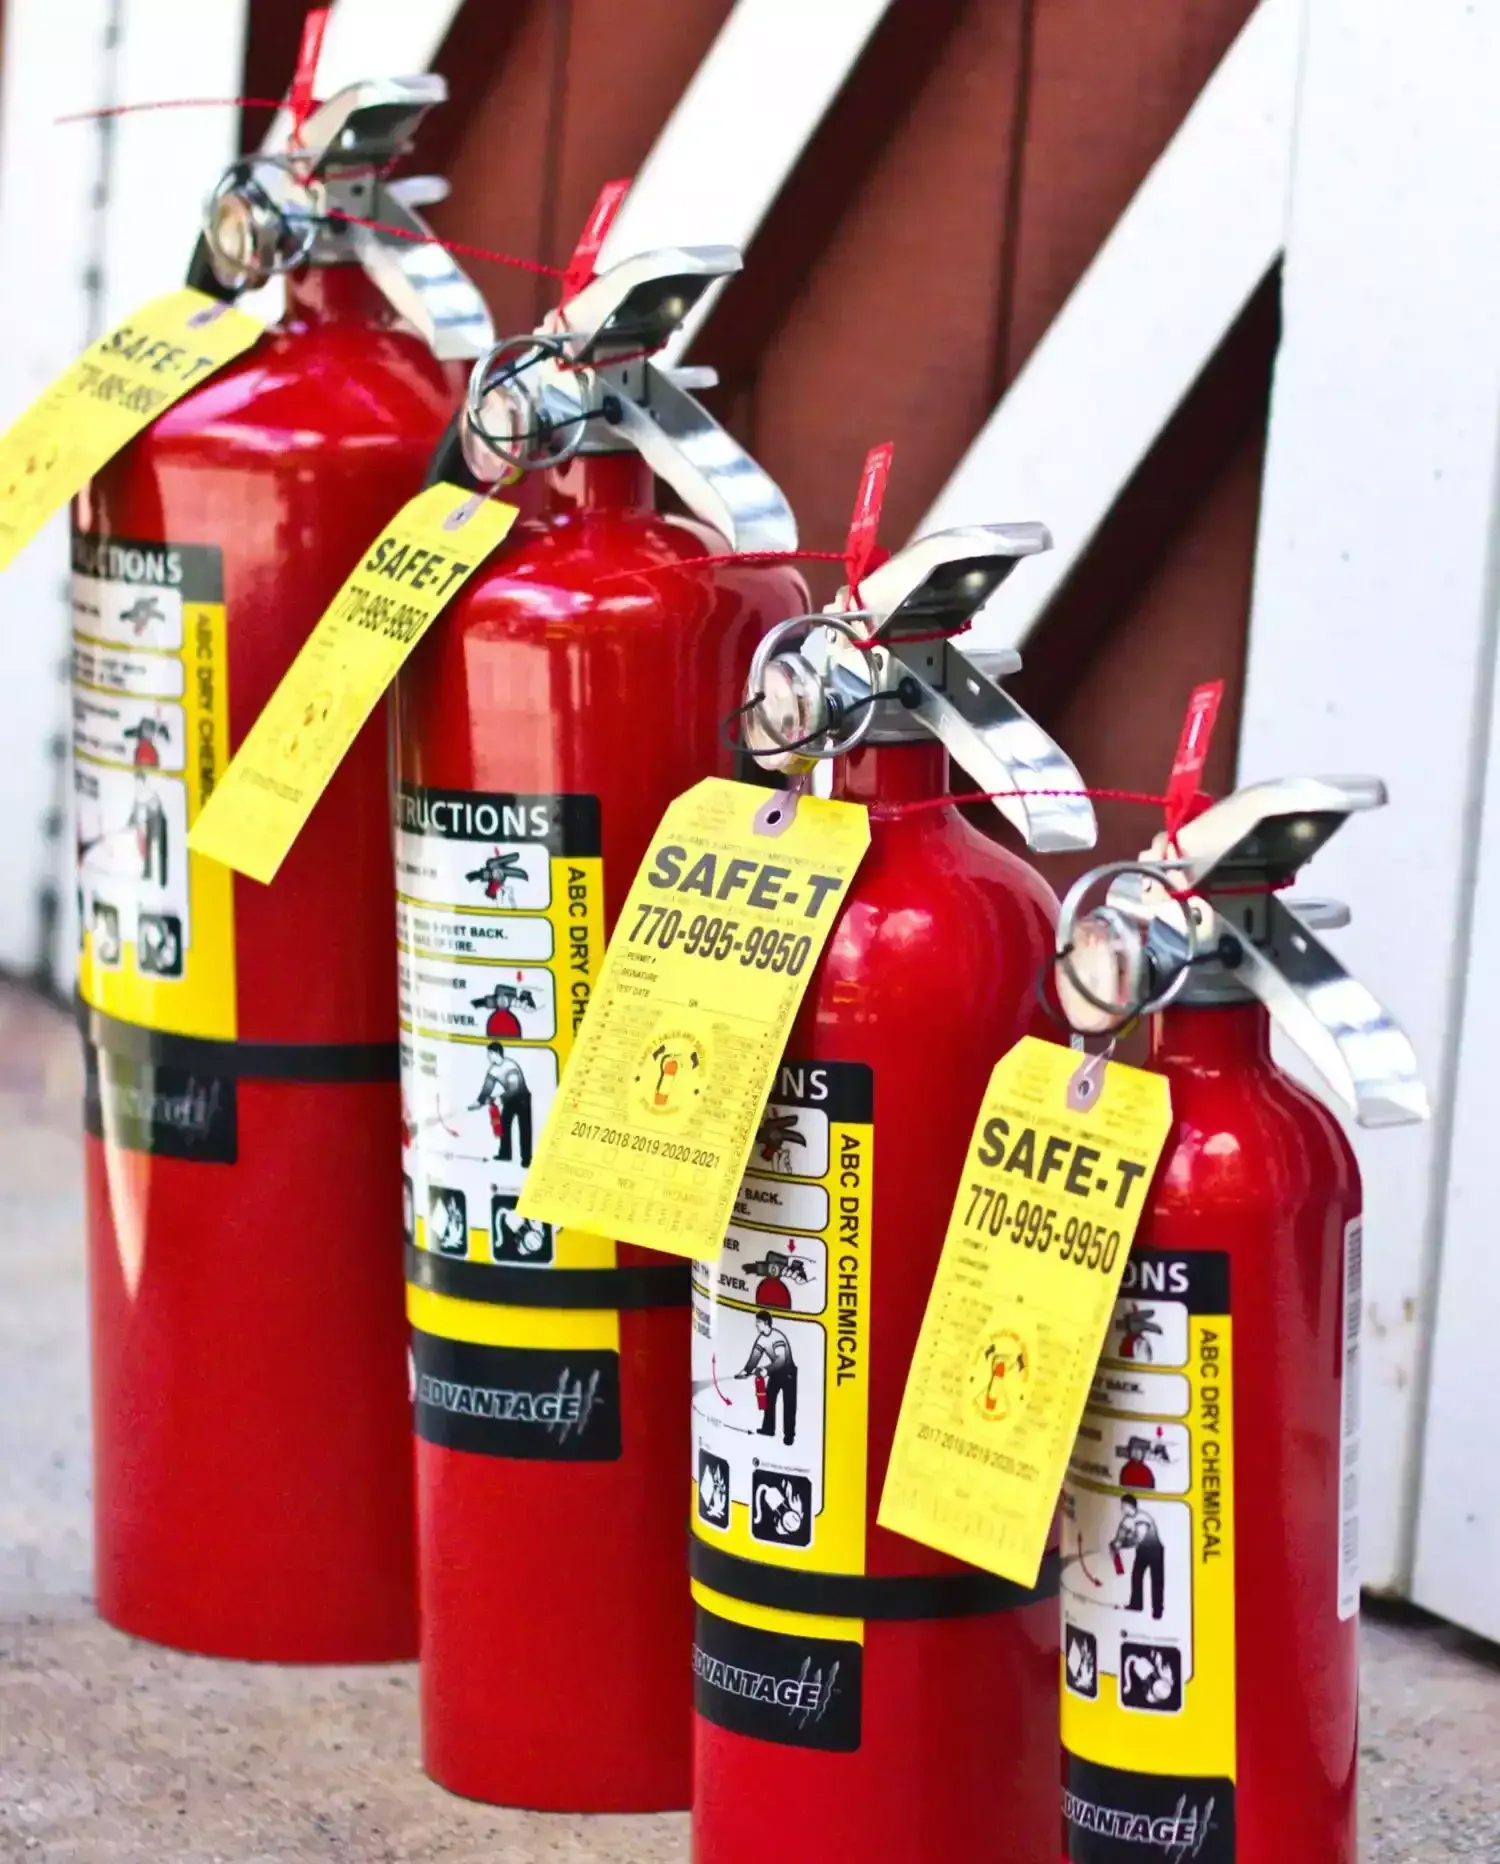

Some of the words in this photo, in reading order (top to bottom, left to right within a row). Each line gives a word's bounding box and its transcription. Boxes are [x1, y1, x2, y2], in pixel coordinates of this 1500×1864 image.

[100, 327, 213, 381] SAFE-T
[366, 537, 470, 596] SAFE-T
[568, 866, 587, 917] ABC
[647, 845, 844, 918] SAFE-T
[470, 926, 508, 940] BACK.
[570, 926, 589, 975] DRY
[628, 903, 812, 976] 770-995-9950
[570, 1121, 600, 1138] 2017
[601, 1128, 630, 1148] 2018
[631, 1135, 660, 1154] 2019
[661, 1142, 691, 1163] 2020
[691, 1149, 720, 1169] 2021
[839, 1133, 860, 1188] ABC
[977, 1117, 1146, 1209] SAFE-T
[744, 1187, 783, 1206] BACK.
[839, 1196, 859, 1248] DRY
[963, 1183, 1121, 1275] 770-995-9950
[836, 1255, 858, 1387] CHEMICAL
[1200, 1328, 1219, 1379] ABC
[1200, 1386, 1220, 1434] DRY
[1202, 1440, 1221, 1564] CHEMICAL
